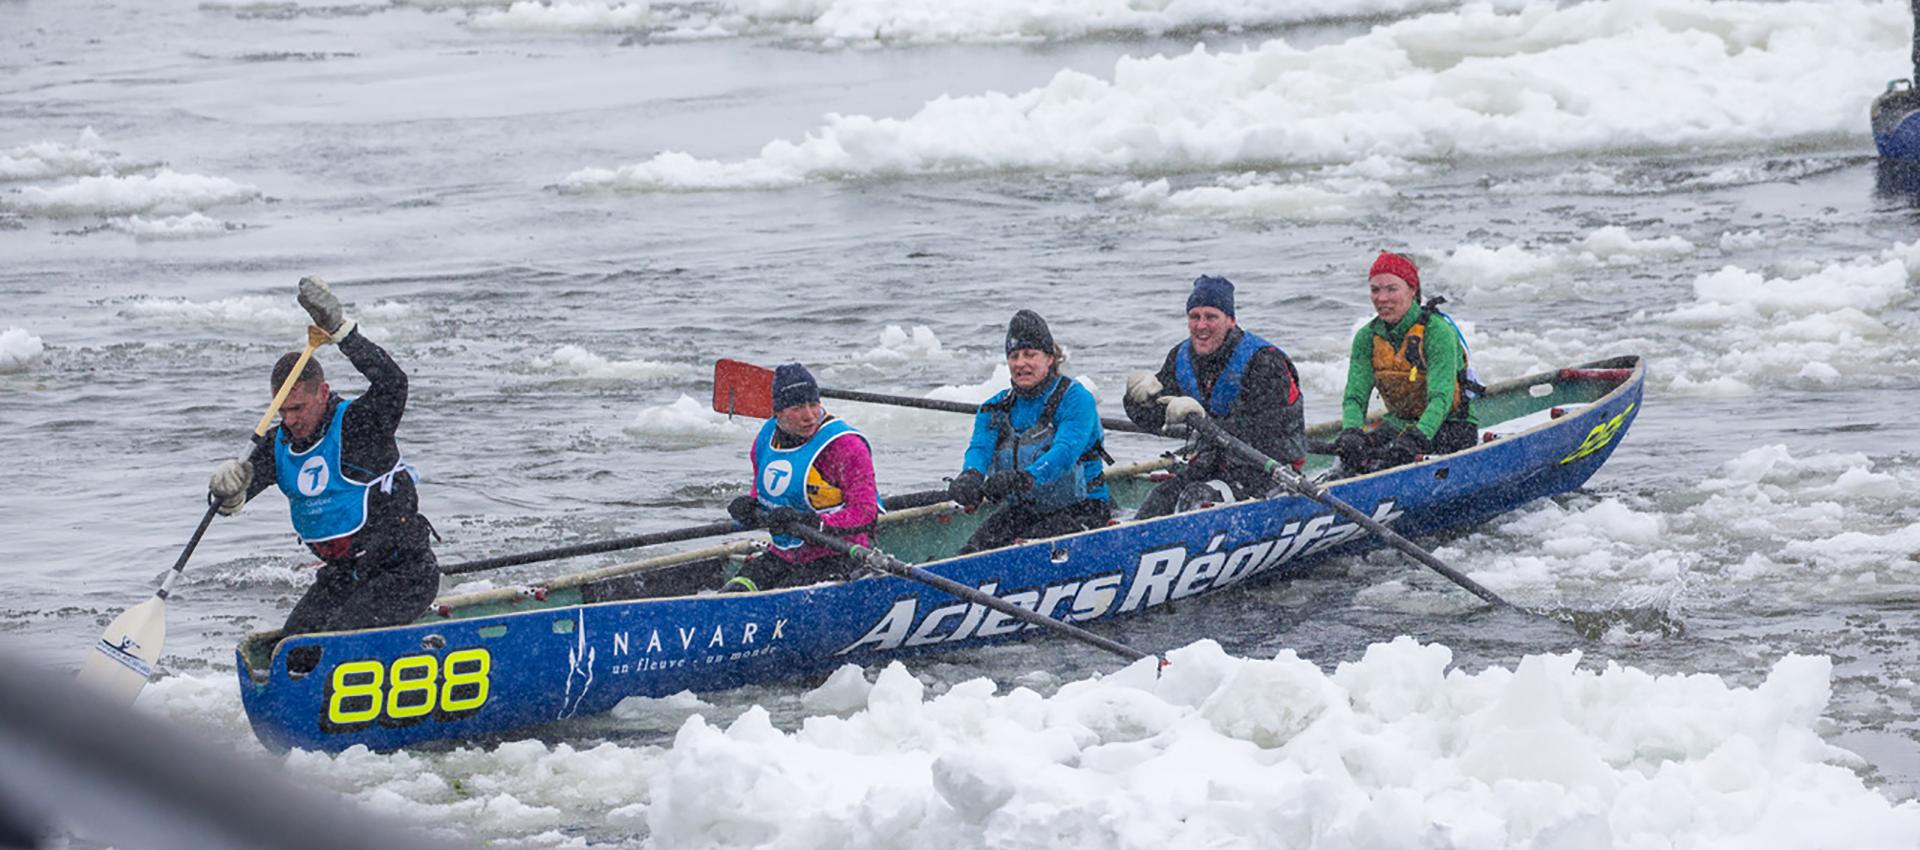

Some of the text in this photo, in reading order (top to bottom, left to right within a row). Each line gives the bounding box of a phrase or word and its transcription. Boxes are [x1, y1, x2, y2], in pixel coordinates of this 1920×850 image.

[613, 618, 788, 656] NAVARK
[612, 644, 778, 674] un fleuve un monde
[328, 648, 491, 724] 888
